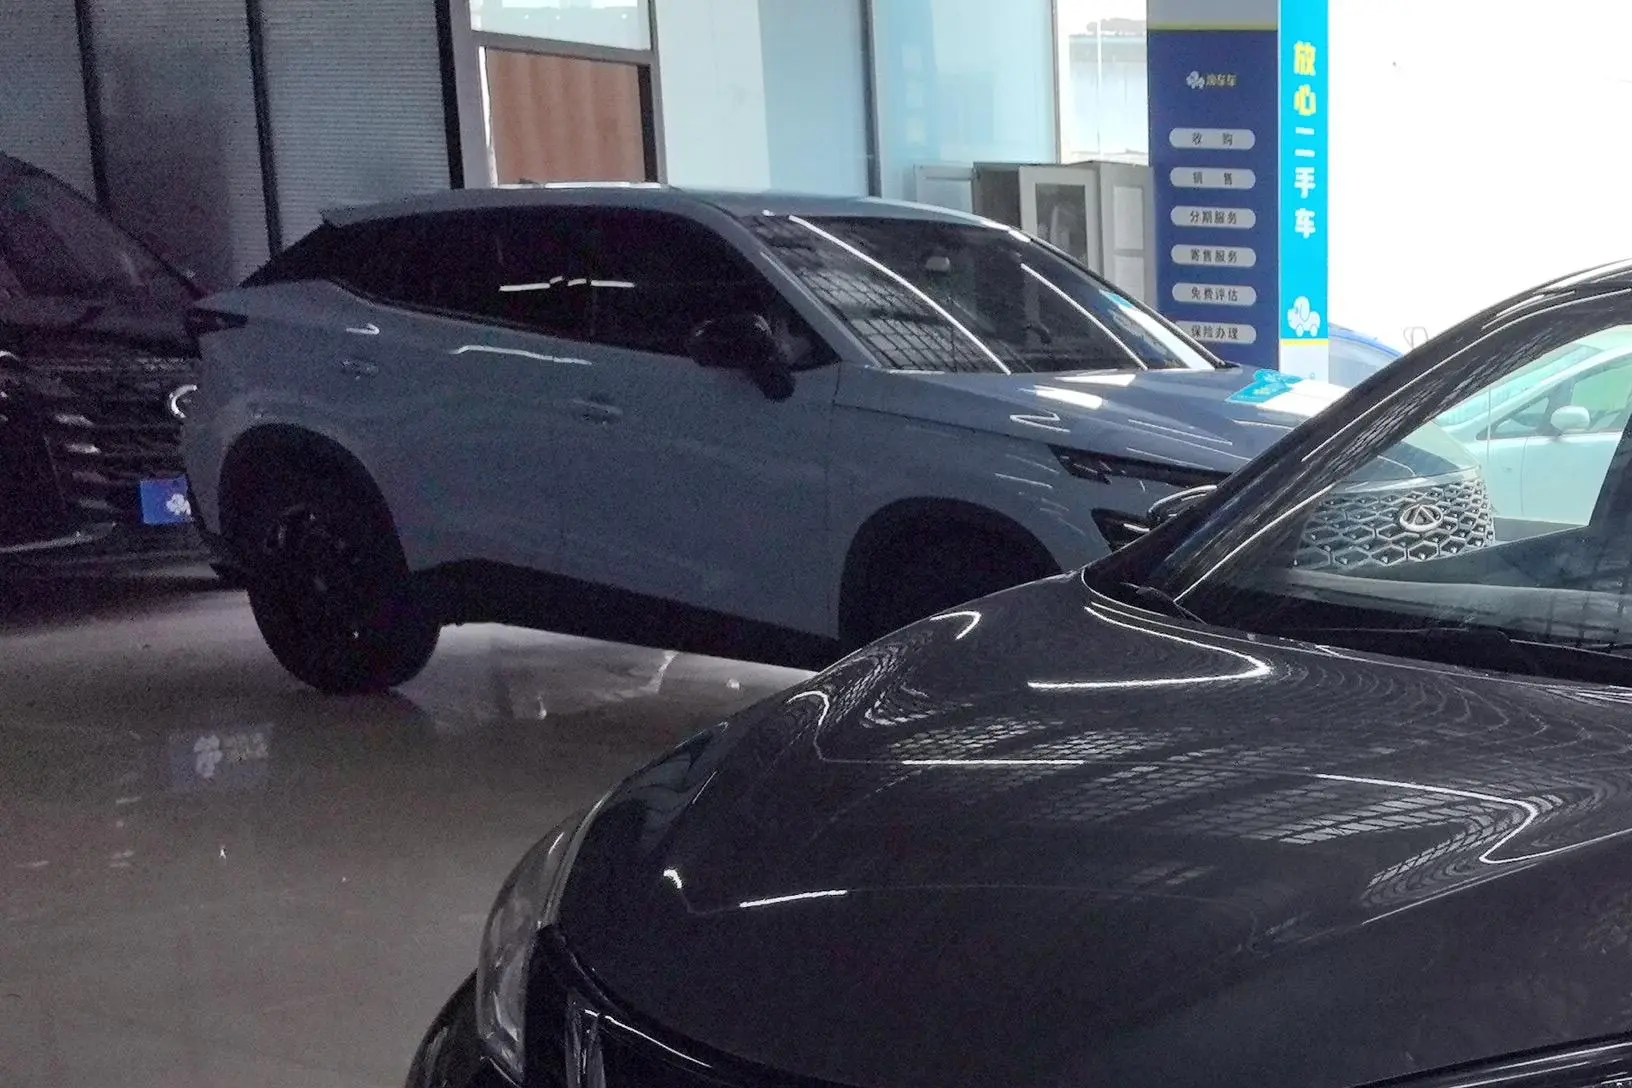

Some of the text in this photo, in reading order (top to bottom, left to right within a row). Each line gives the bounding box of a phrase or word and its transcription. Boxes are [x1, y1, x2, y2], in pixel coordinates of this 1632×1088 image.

[1294, 41, 1316, 238] 放心二手车
[1190, 210, 1237, 224] 分期服务
[1190, 248, 1238, 263] 寄售服务
[1191, 286, 1239, 302] 免费评估
[1191, 324, 1239, 340] 保险办理
